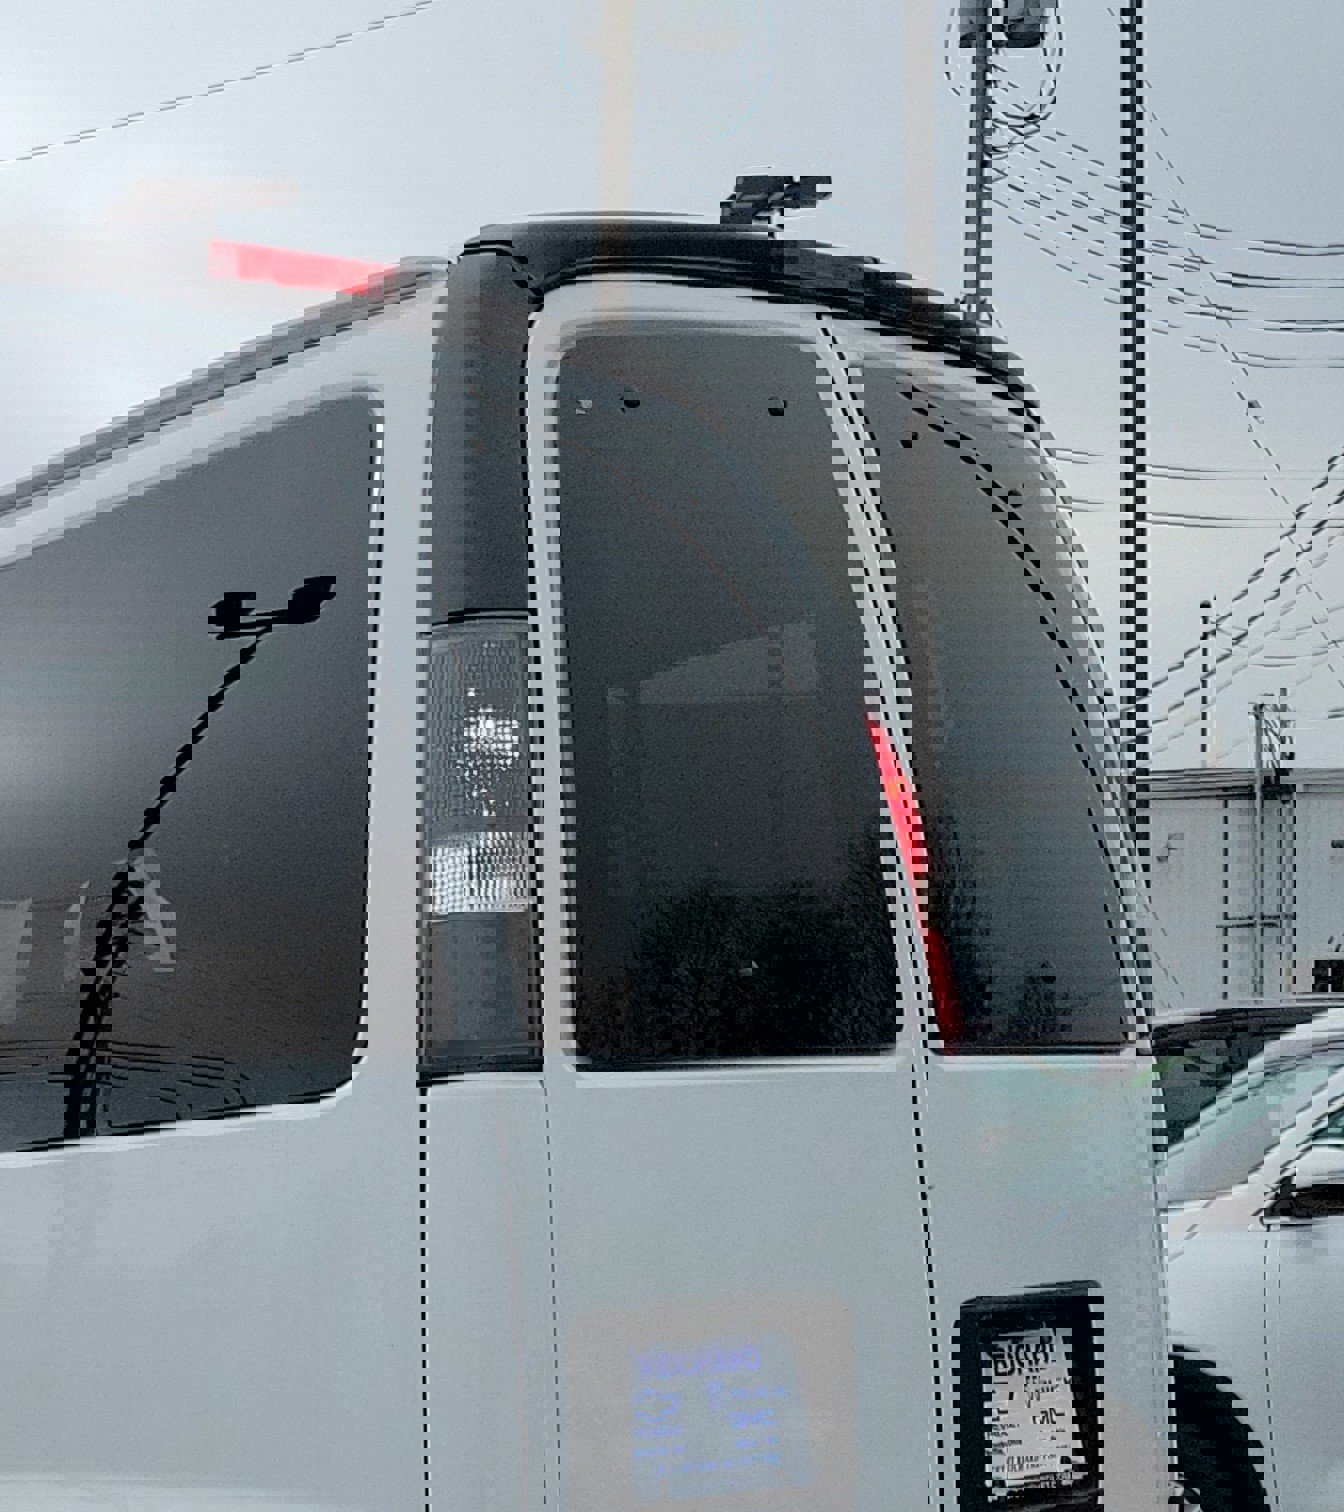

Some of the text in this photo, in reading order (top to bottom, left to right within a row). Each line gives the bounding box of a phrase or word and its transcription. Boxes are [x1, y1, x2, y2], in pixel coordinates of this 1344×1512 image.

[640, 1347, 761, 1380] REICHARD
[731, 1384, 790, 1401] BUICK
[728, 1409, 777, 1429] GMC
[634, 1425, 684, 1440] HEVROLET
